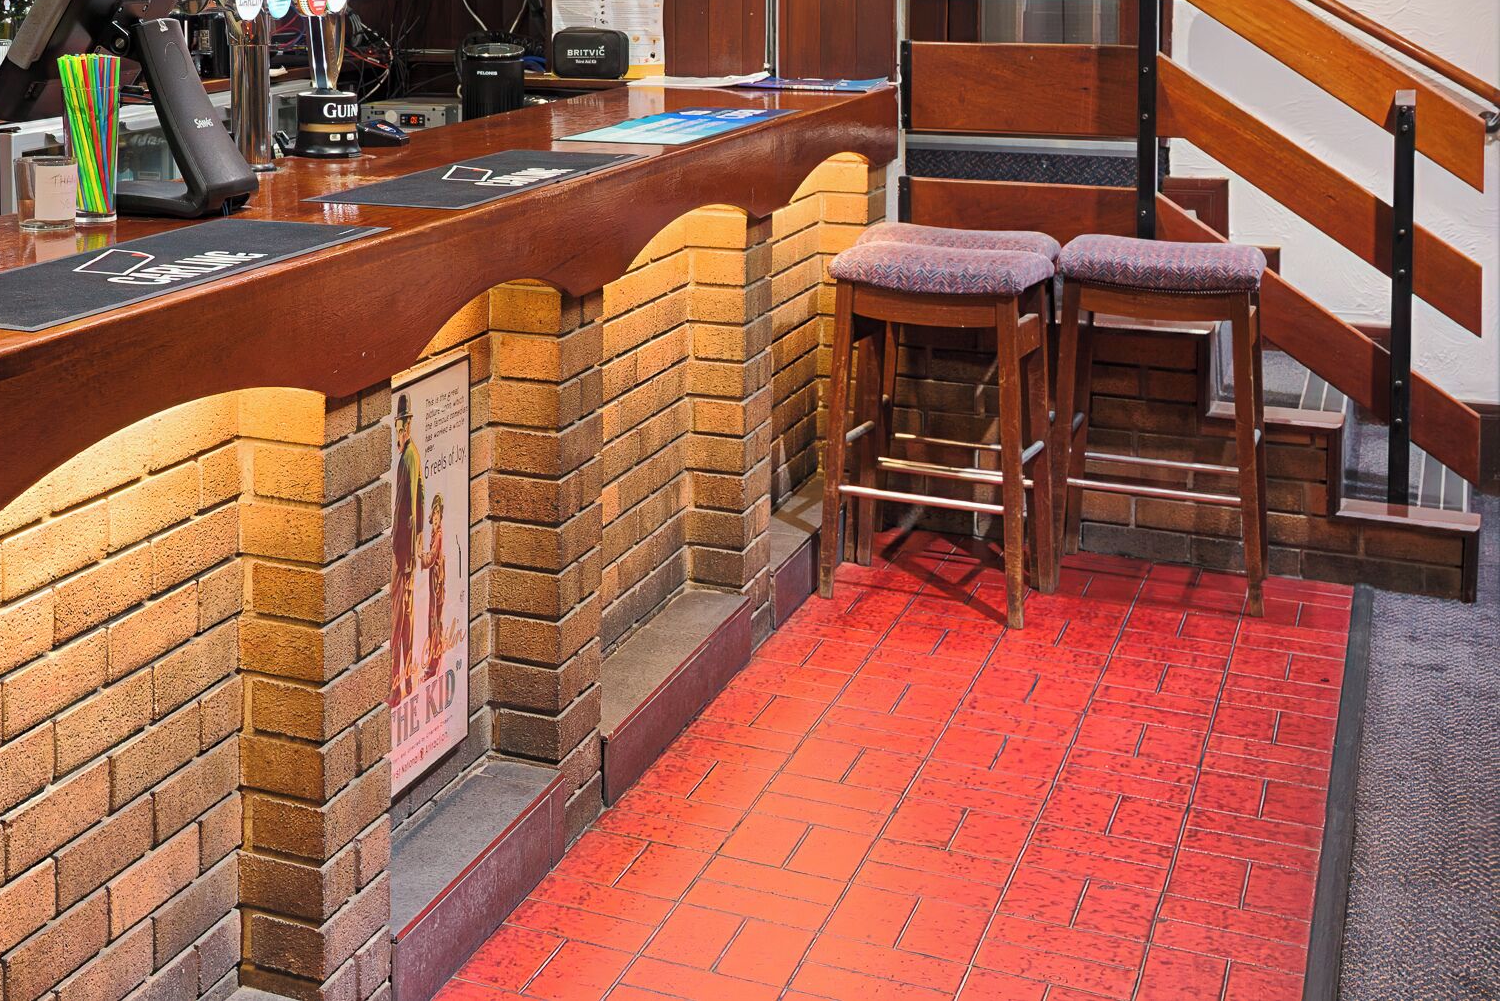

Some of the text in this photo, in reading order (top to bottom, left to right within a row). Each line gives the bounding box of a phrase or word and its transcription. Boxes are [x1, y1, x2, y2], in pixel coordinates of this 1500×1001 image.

[567, 45, 606, 57] BRITVIC
[106, 250, 269, 286] CARLING
[433, 426, 449, 438] worked
[424, 443, 467, 479] 6 reels of Joy.
